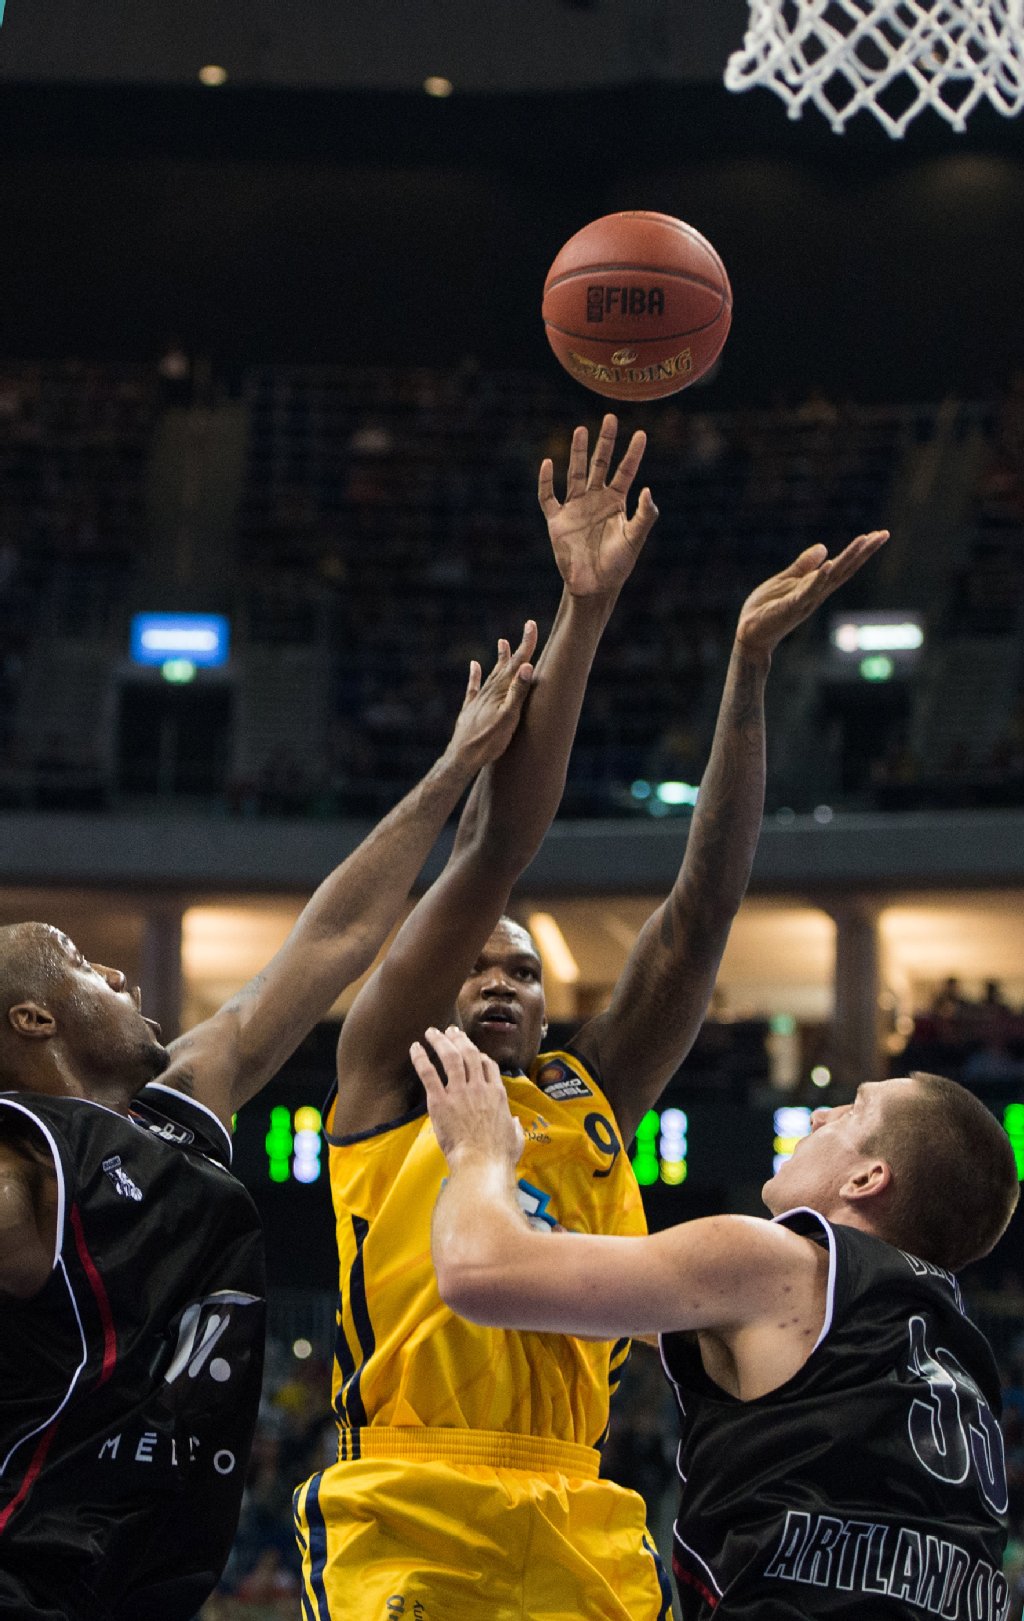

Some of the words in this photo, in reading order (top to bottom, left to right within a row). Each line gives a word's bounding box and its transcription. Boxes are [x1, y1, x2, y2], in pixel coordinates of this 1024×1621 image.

[606, 287, 665, 315] FIBA
[583, 1112, 621, 1178] 9
[764, 1511, 970, 1620] ARTLAND
